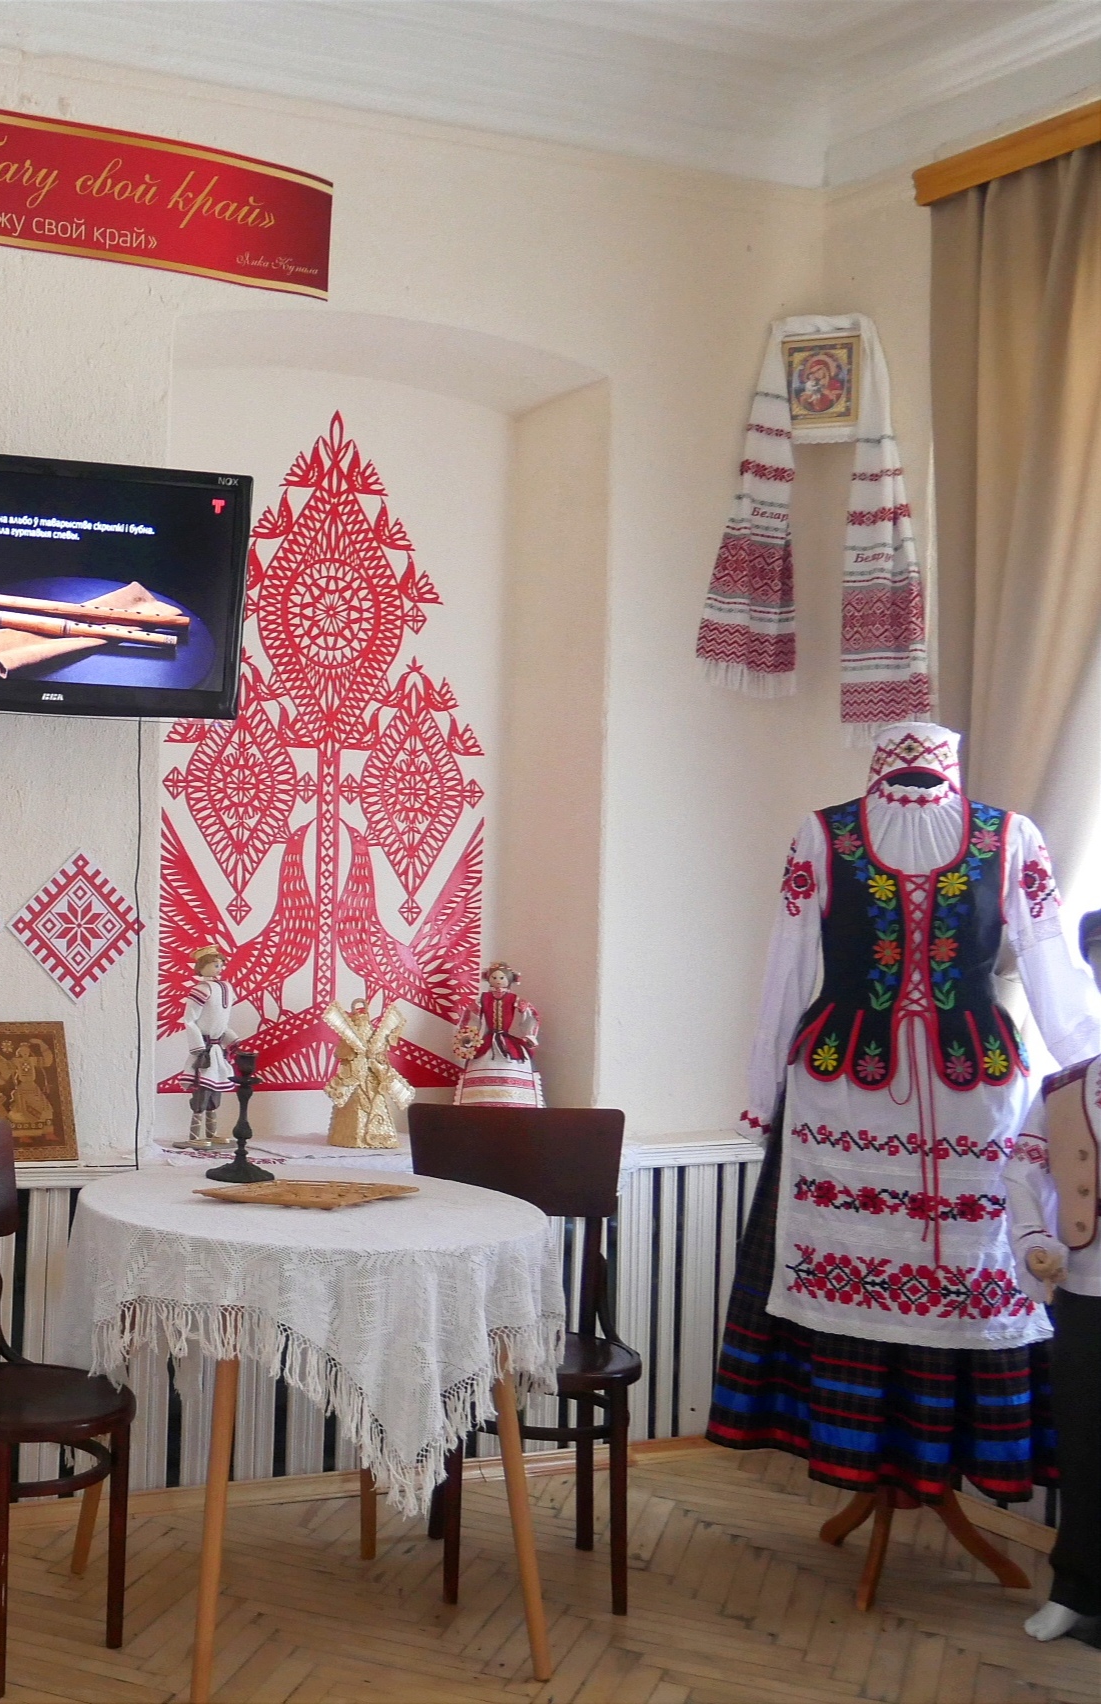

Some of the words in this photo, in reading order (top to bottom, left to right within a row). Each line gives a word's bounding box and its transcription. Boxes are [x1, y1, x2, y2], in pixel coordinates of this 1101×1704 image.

[75, 158, 158, 206] свой
[167, 170, 276, 229] край»
[32, 217, 86, 240] свой
[93, 226, 158, 249] край»
